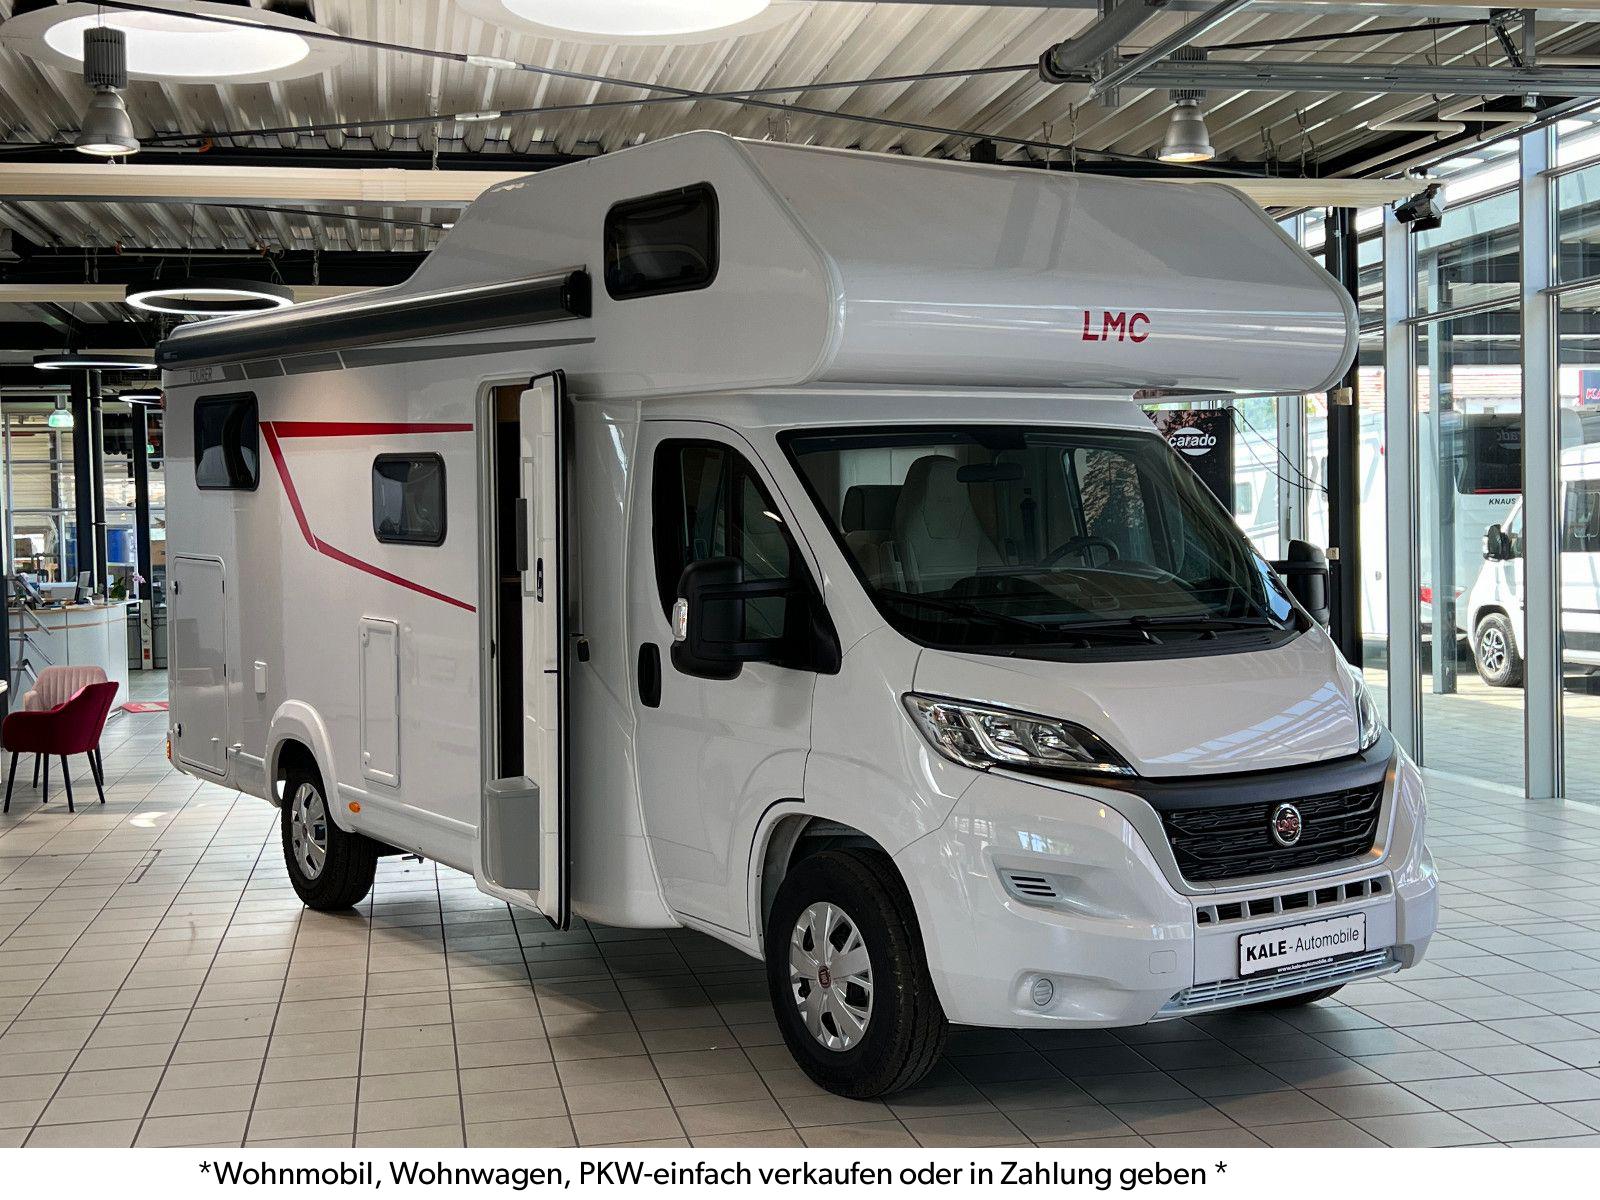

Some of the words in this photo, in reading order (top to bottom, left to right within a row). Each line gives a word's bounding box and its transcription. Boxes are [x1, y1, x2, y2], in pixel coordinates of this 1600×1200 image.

[1082, 310, 1151, 343] LMC
[1168, 433, 1217, 447] carado
[1488, 497, 1517, 506] KNAUS
[1246, 940, 1288, 962] KALE
